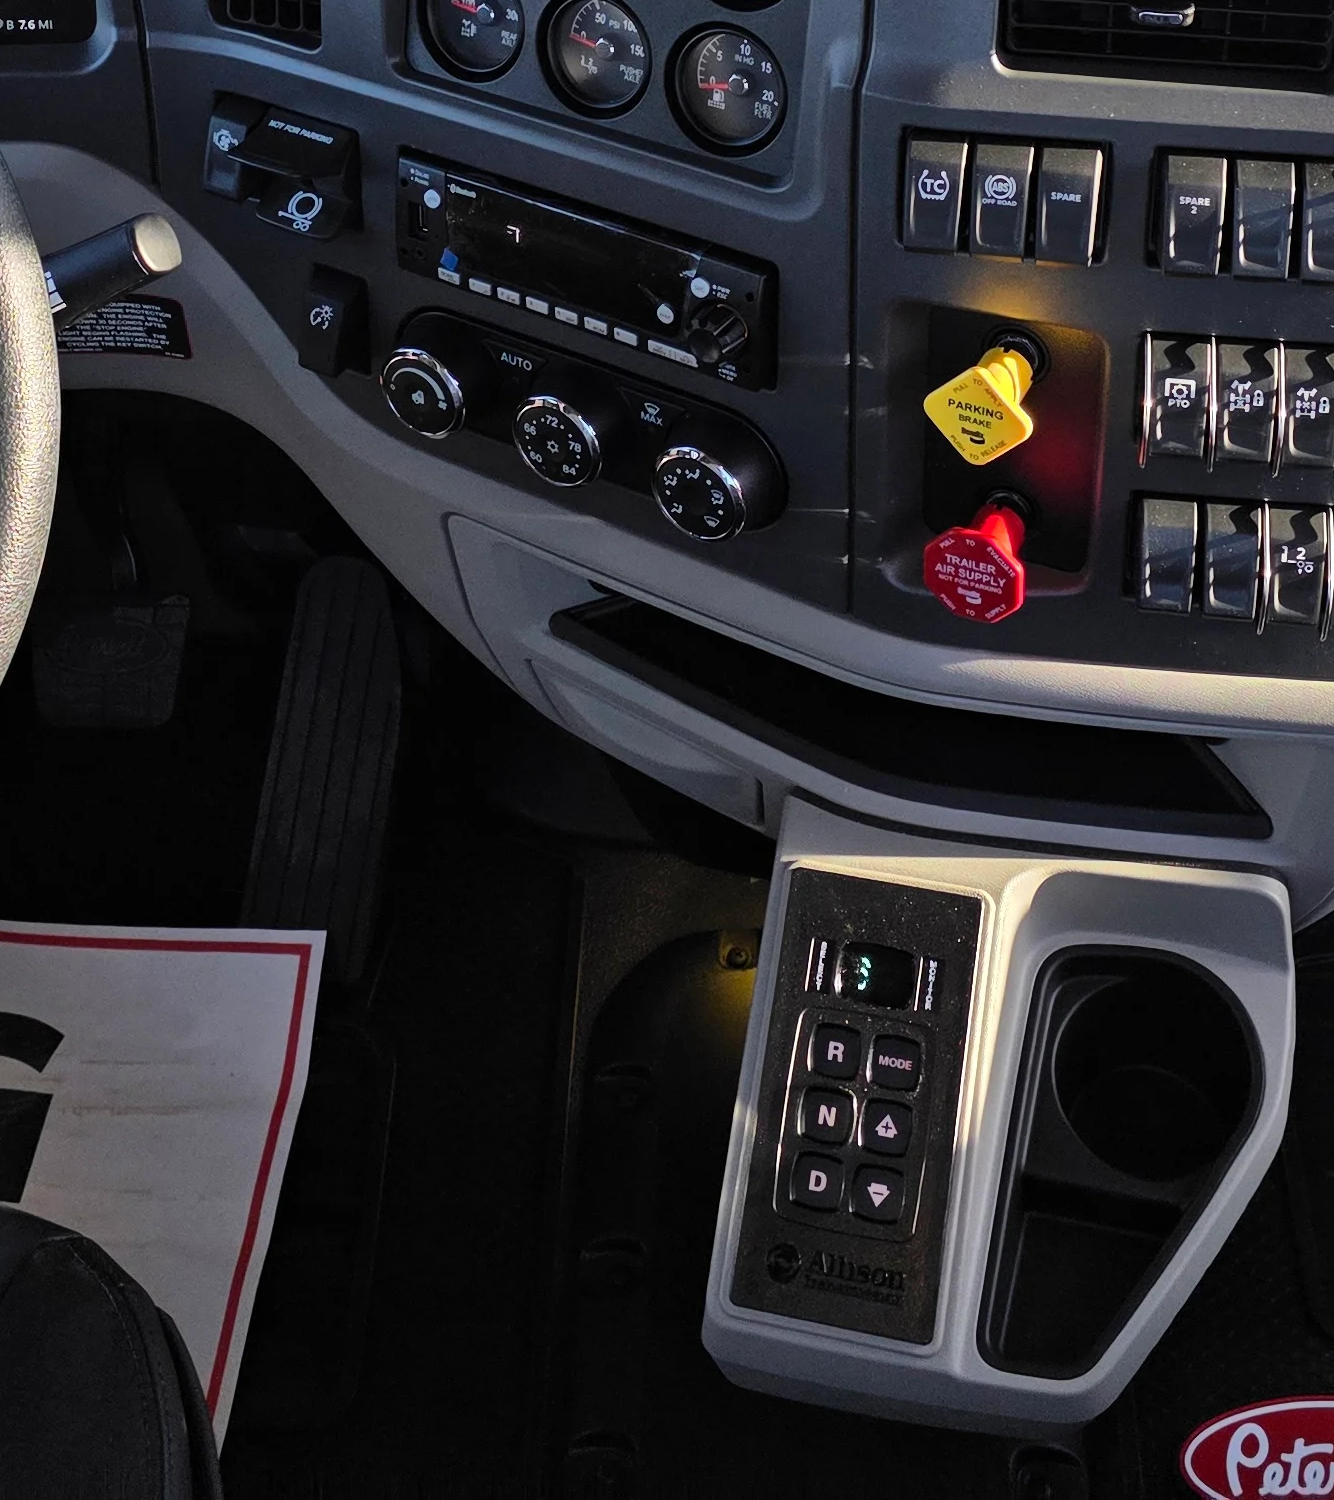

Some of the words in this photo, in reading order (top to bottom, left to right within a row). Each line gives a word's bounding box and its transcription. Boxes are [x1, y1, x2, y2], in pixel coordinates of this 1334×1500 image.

[6, 20, 14, 30] B
[18, 19, 36, 30] 7.6
[38, 20, 53, 30] MI
[595, 12, 606, 25] 50
[608, 19, 621, 30] PSI
[716, 50, 723, 62] 5
[739, 43, 751, 56] 10
[761, 61, 772, 74] 15
[761, 89, 774, 102] 20
[754, 101, 772, 113] FUEL
[754, 109, 772, 120] FLTR
[268, 119, 283, 130] NOT
[283, 124, 301, 135] FOR
[299, 128, 334, 145] PARKING
[923, 178, 945, 193] TC
[992, 182, 1010, 193] ABS
[982, 197, 996, 205] OFF
[997, 199, 1017, 207] ROAD
[1050, 191, 1082, 203] SPARE
[1179, 195, 1211, 206] SPARE
[1190, 206, 1198, 215] 2
[125, 308, 172, 319] PROTECTION
[144, 321, 167, 329] AFTER
[115, 336, 159, 345] RESTARTED
[500, 351, 533, 371] AUTO
[952, 383, 969, 394] PULL
[973, 378, 983, 386] TO
[983, 388, 1003, 408] APPLY
[948, 398, 1004, 420] PARKING
[1168, 399, 1191, 409] PTO
[545, 414, 559, 428] 72
[640, 410, 663, 427] MAX
[958, 413, 992, 429] BRAKE
[523, 422, 537, 436] 66
[568, 440, 582, 453] 78
[950, 434, 966, 452] PUSH
[969, 453, 979, 461] TO
[980, 439, 1008, 458] RELEASE
[529, 451, 543, 463] 60
[562, 464, 577, 476] 84
[939, 537, 955, 549] PULL
[965, 538, 976, 547] TO
[986, 546, 1016, 578] EVACUATE
[944, 553, 996, 575] TRAILER
[934, 562, 955, 576] AIR
[958, 568, 1007, 588] SUPPLY
[938, 573, 953, 582] NOT
[954, 577, 969, 586] FOR
[970, 581, 1003, 595] PARKING
[939, 593, 957, 611] PUSH
[965, 608, 976, 617] TO
[984, 603, 1007, 620] SUPPLY
[816, 941, 828, 991] SELECT
[924, 959, 938, 1011] MONITOR
[827, 1040, 845, 1063] R
[878, 1054, 913, 1071] MODE
[817, 1104, 837, 1127] N
[808, 1169, 828, 1193] D
